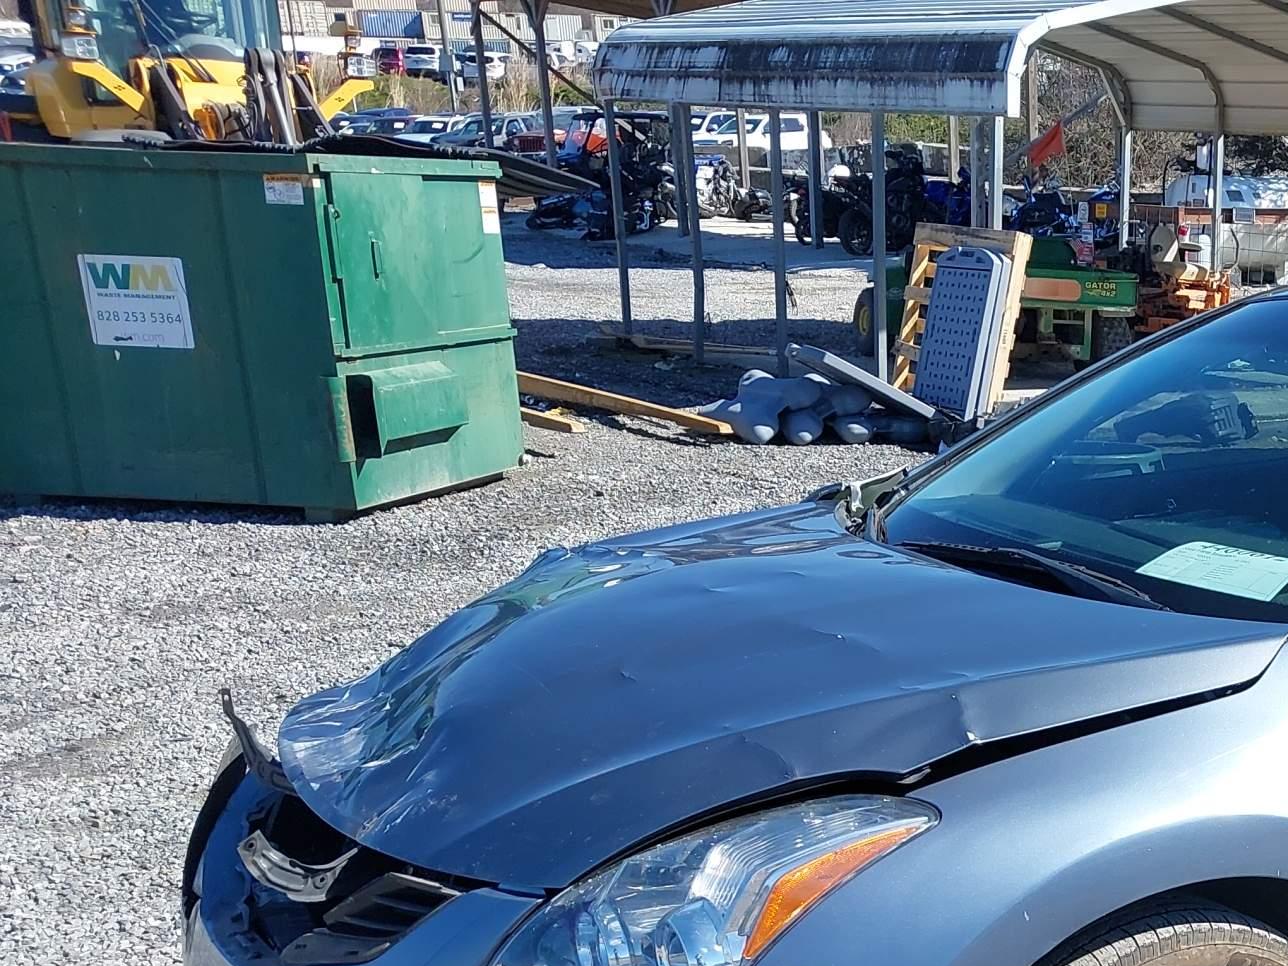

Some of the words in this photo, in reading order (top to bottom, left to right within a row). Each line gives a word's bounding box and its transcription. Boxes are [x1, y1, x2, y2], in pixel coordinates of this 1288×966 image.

[85, 262, 177, 291] WM
[1085, 281, 1116, 290] GATOR
[123, 293, 176, 301] MANAGEMENT
[97, 310, 120, 321] 828
[123, 311, 146, 323] 253
[150, 312, 182, 324] 5364
